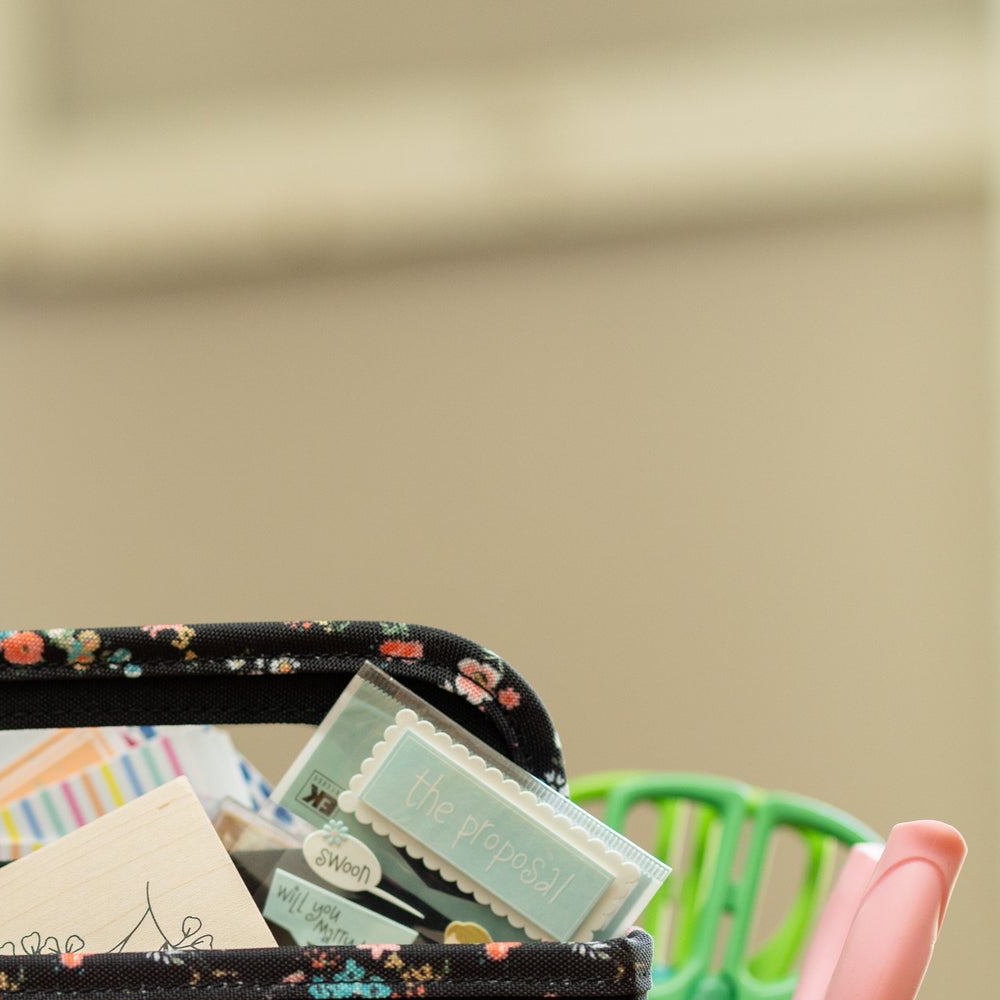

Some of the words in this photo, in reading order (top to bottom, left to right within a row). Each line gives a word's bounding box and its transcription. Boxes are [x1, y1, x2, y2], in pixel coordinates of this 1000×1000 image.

[302, 783, 338, 817] EK
[405, 769, 454, 824] the
[450, 814, 576, 904] proposal
[277, 884, 310, 915] will
[305, 900, 342, 923] you
